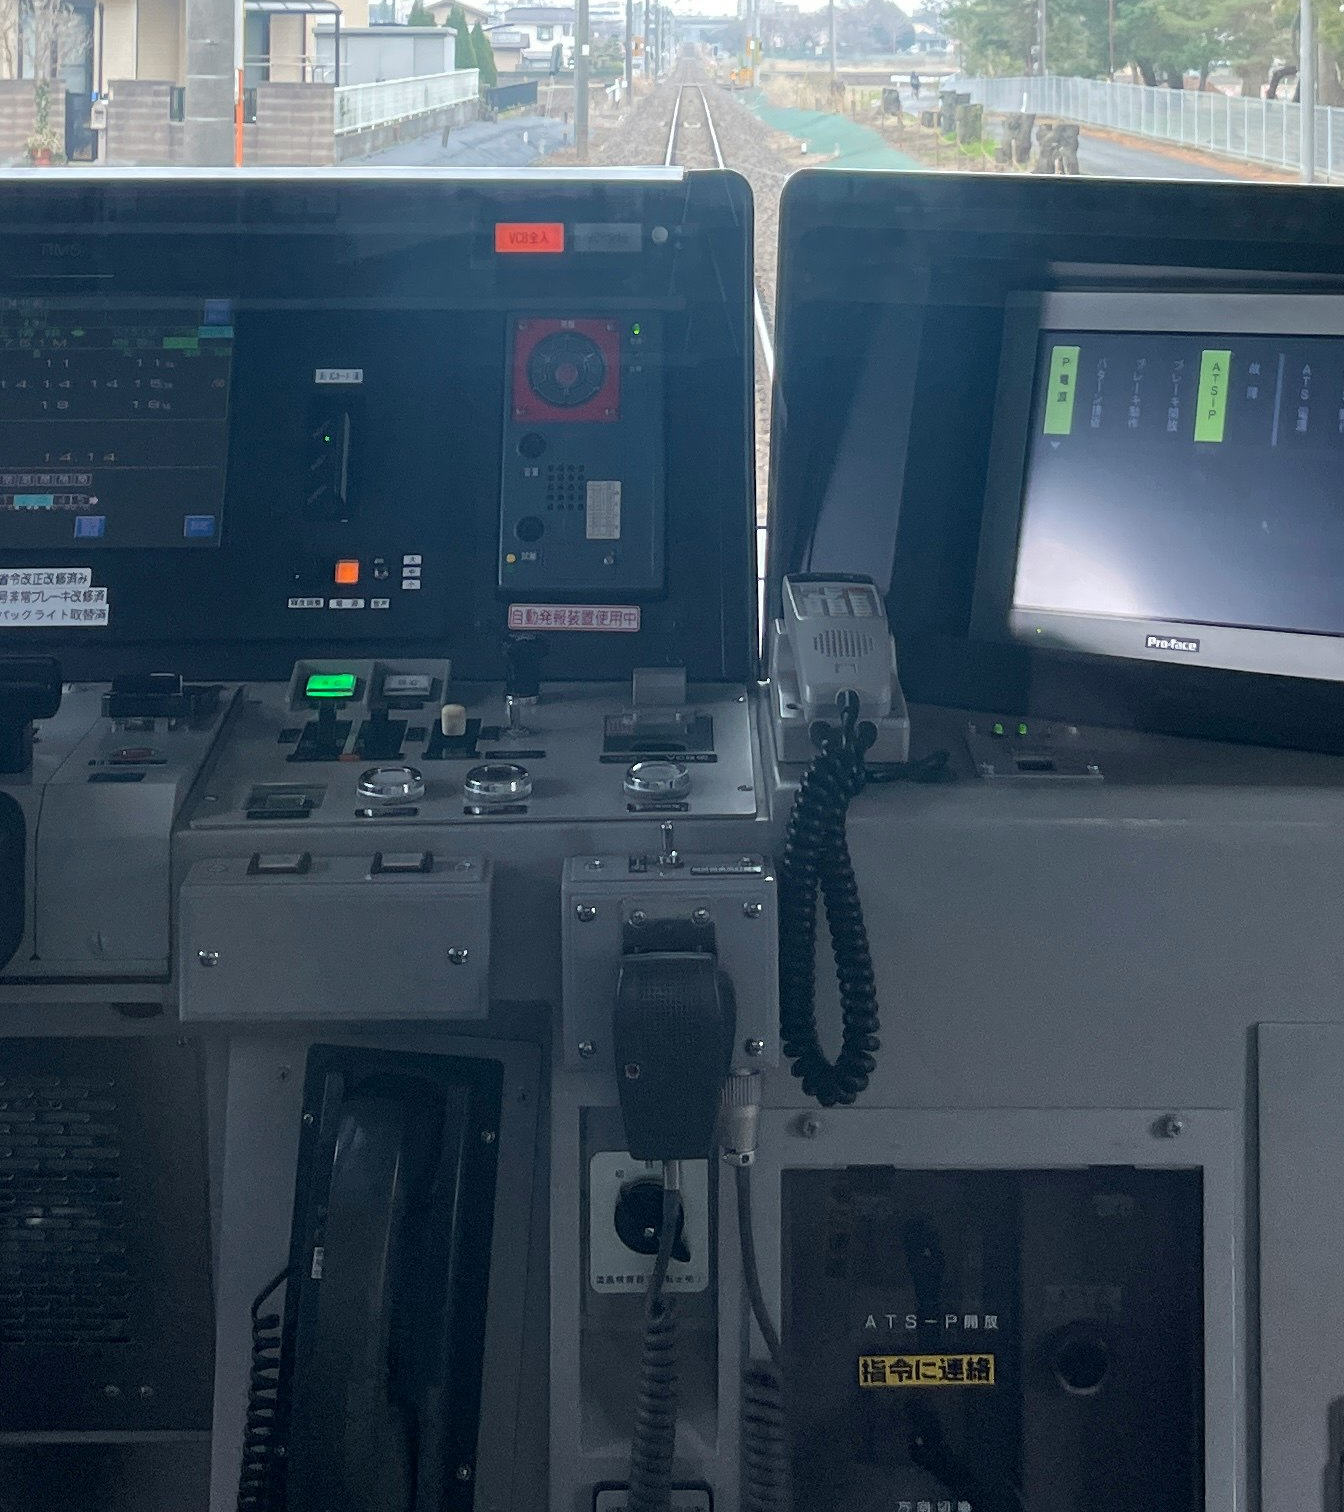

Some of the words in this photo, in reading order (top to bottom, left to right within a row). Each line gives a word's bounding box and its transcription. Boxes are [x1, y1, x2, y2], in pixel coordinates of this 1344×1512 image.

[511, 608, 637, 627] 自動発報装置使用中
[1146, 636, 1197, 652] Pro-face
[861, 1357, 991, 1383] 指令に連絡
